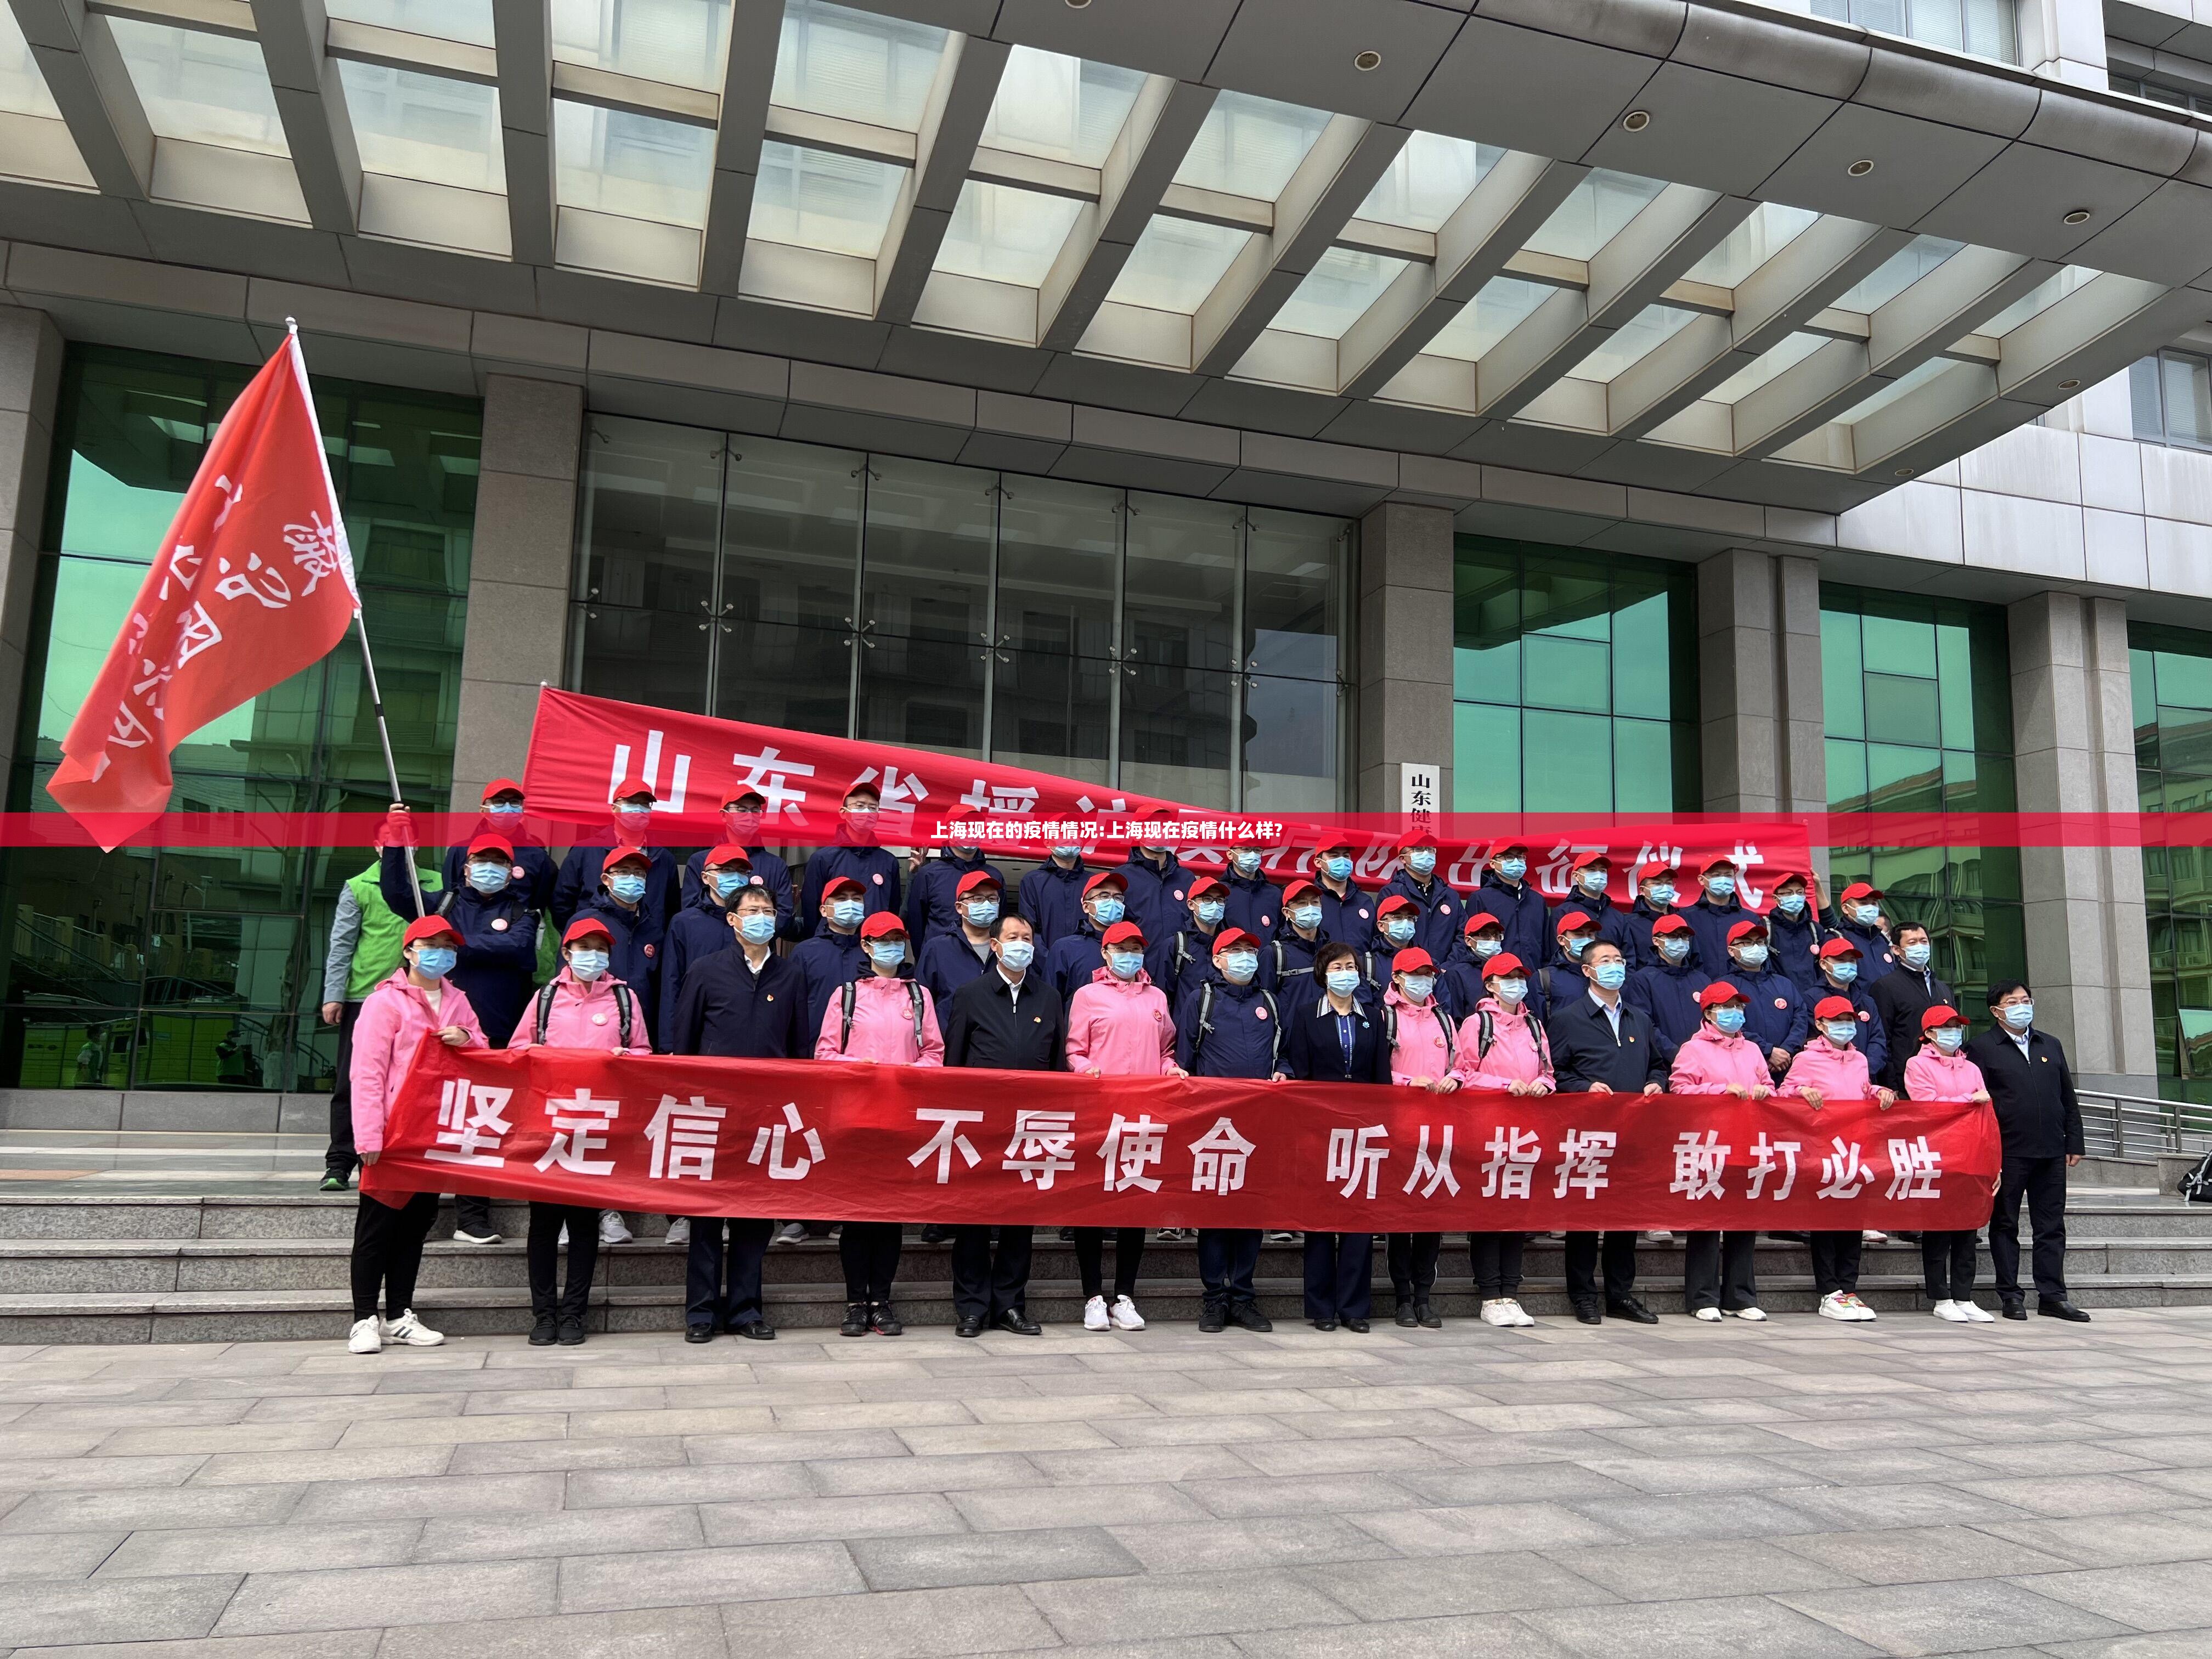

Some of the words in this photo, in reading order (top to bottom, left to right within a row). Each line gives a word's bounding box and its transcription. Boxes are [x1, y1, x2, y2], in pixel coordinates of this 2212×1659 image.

[424, 1078, 826, 1181] 坚定信心
[907, 1108, 1257, 1196] 不辱使命
[1325, 1124, 1617, 1200] 听从指挥
[1669, 1129, 1942, 1201] 敢打必胜
